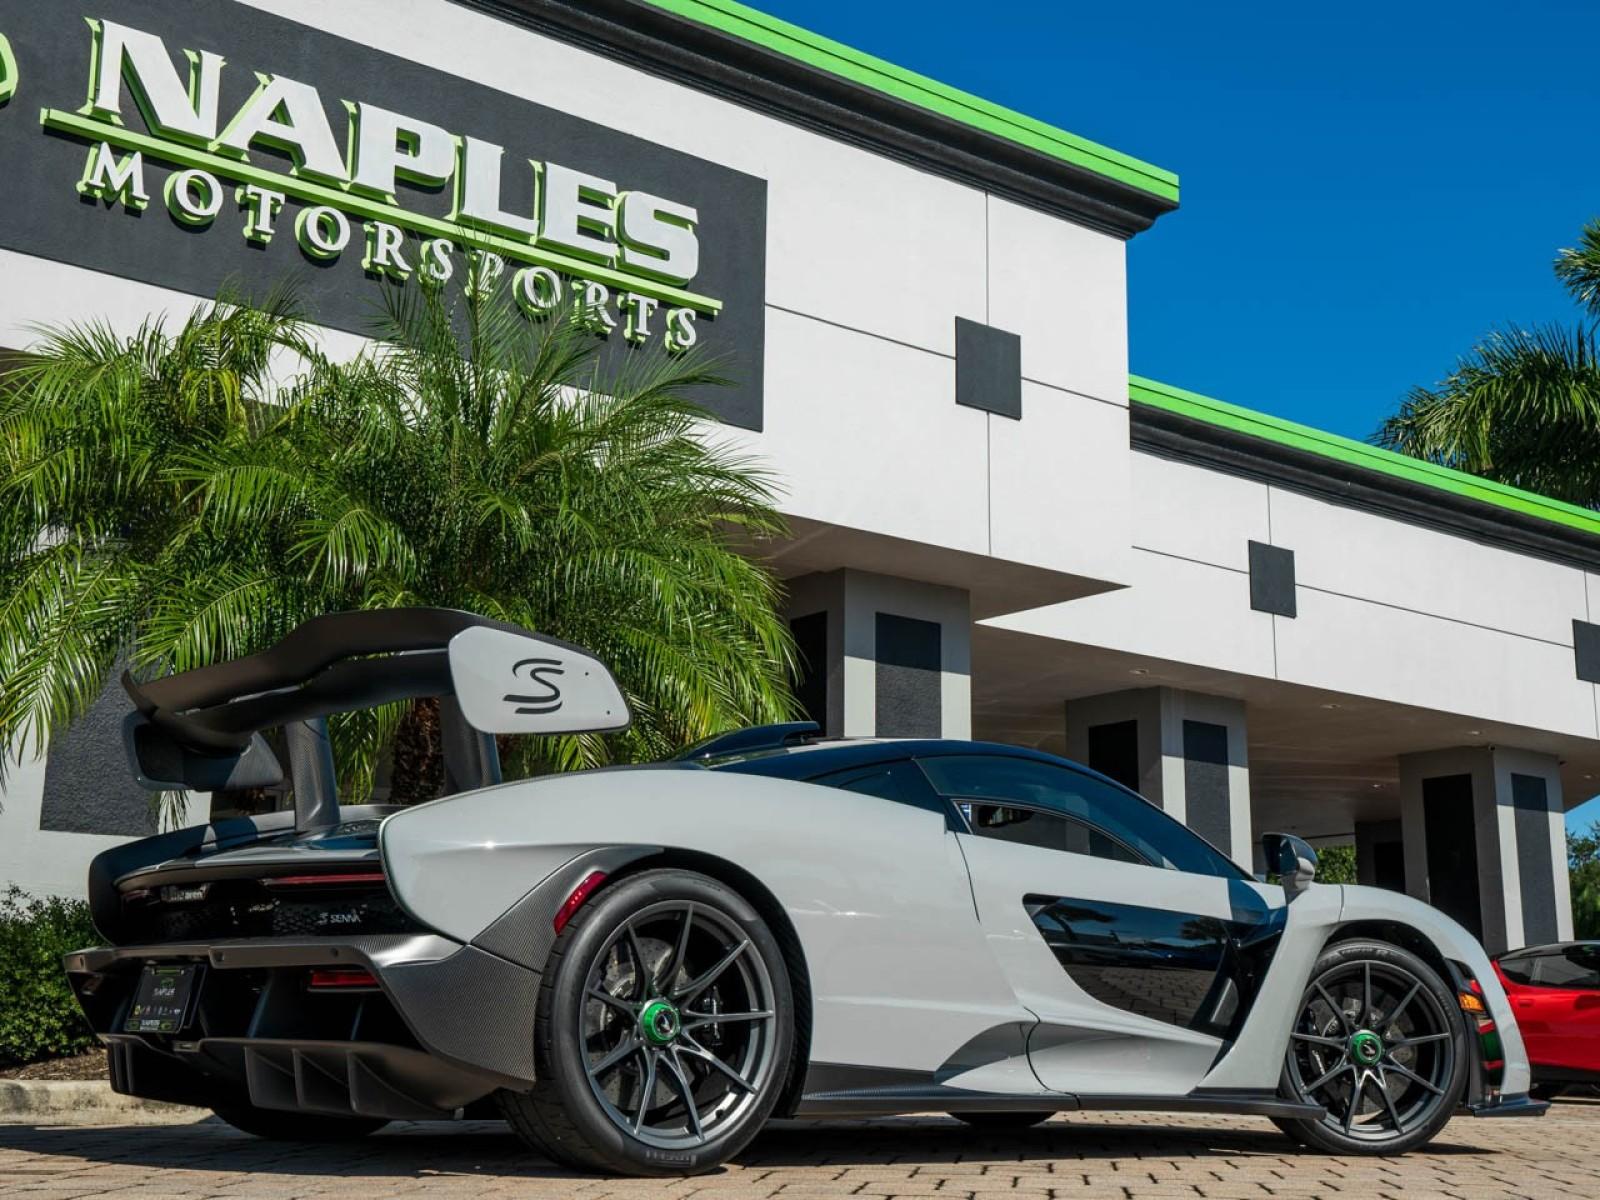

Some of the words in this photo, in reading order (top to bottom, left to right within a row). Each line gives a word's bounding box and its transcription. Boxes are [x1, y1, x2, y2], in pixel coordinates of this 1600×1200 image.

[76, 142, 696, 352] MOTORSPORTS
[78, 18, 699, 282] NAPLES
[330, 913, 361, 923] SENNA
